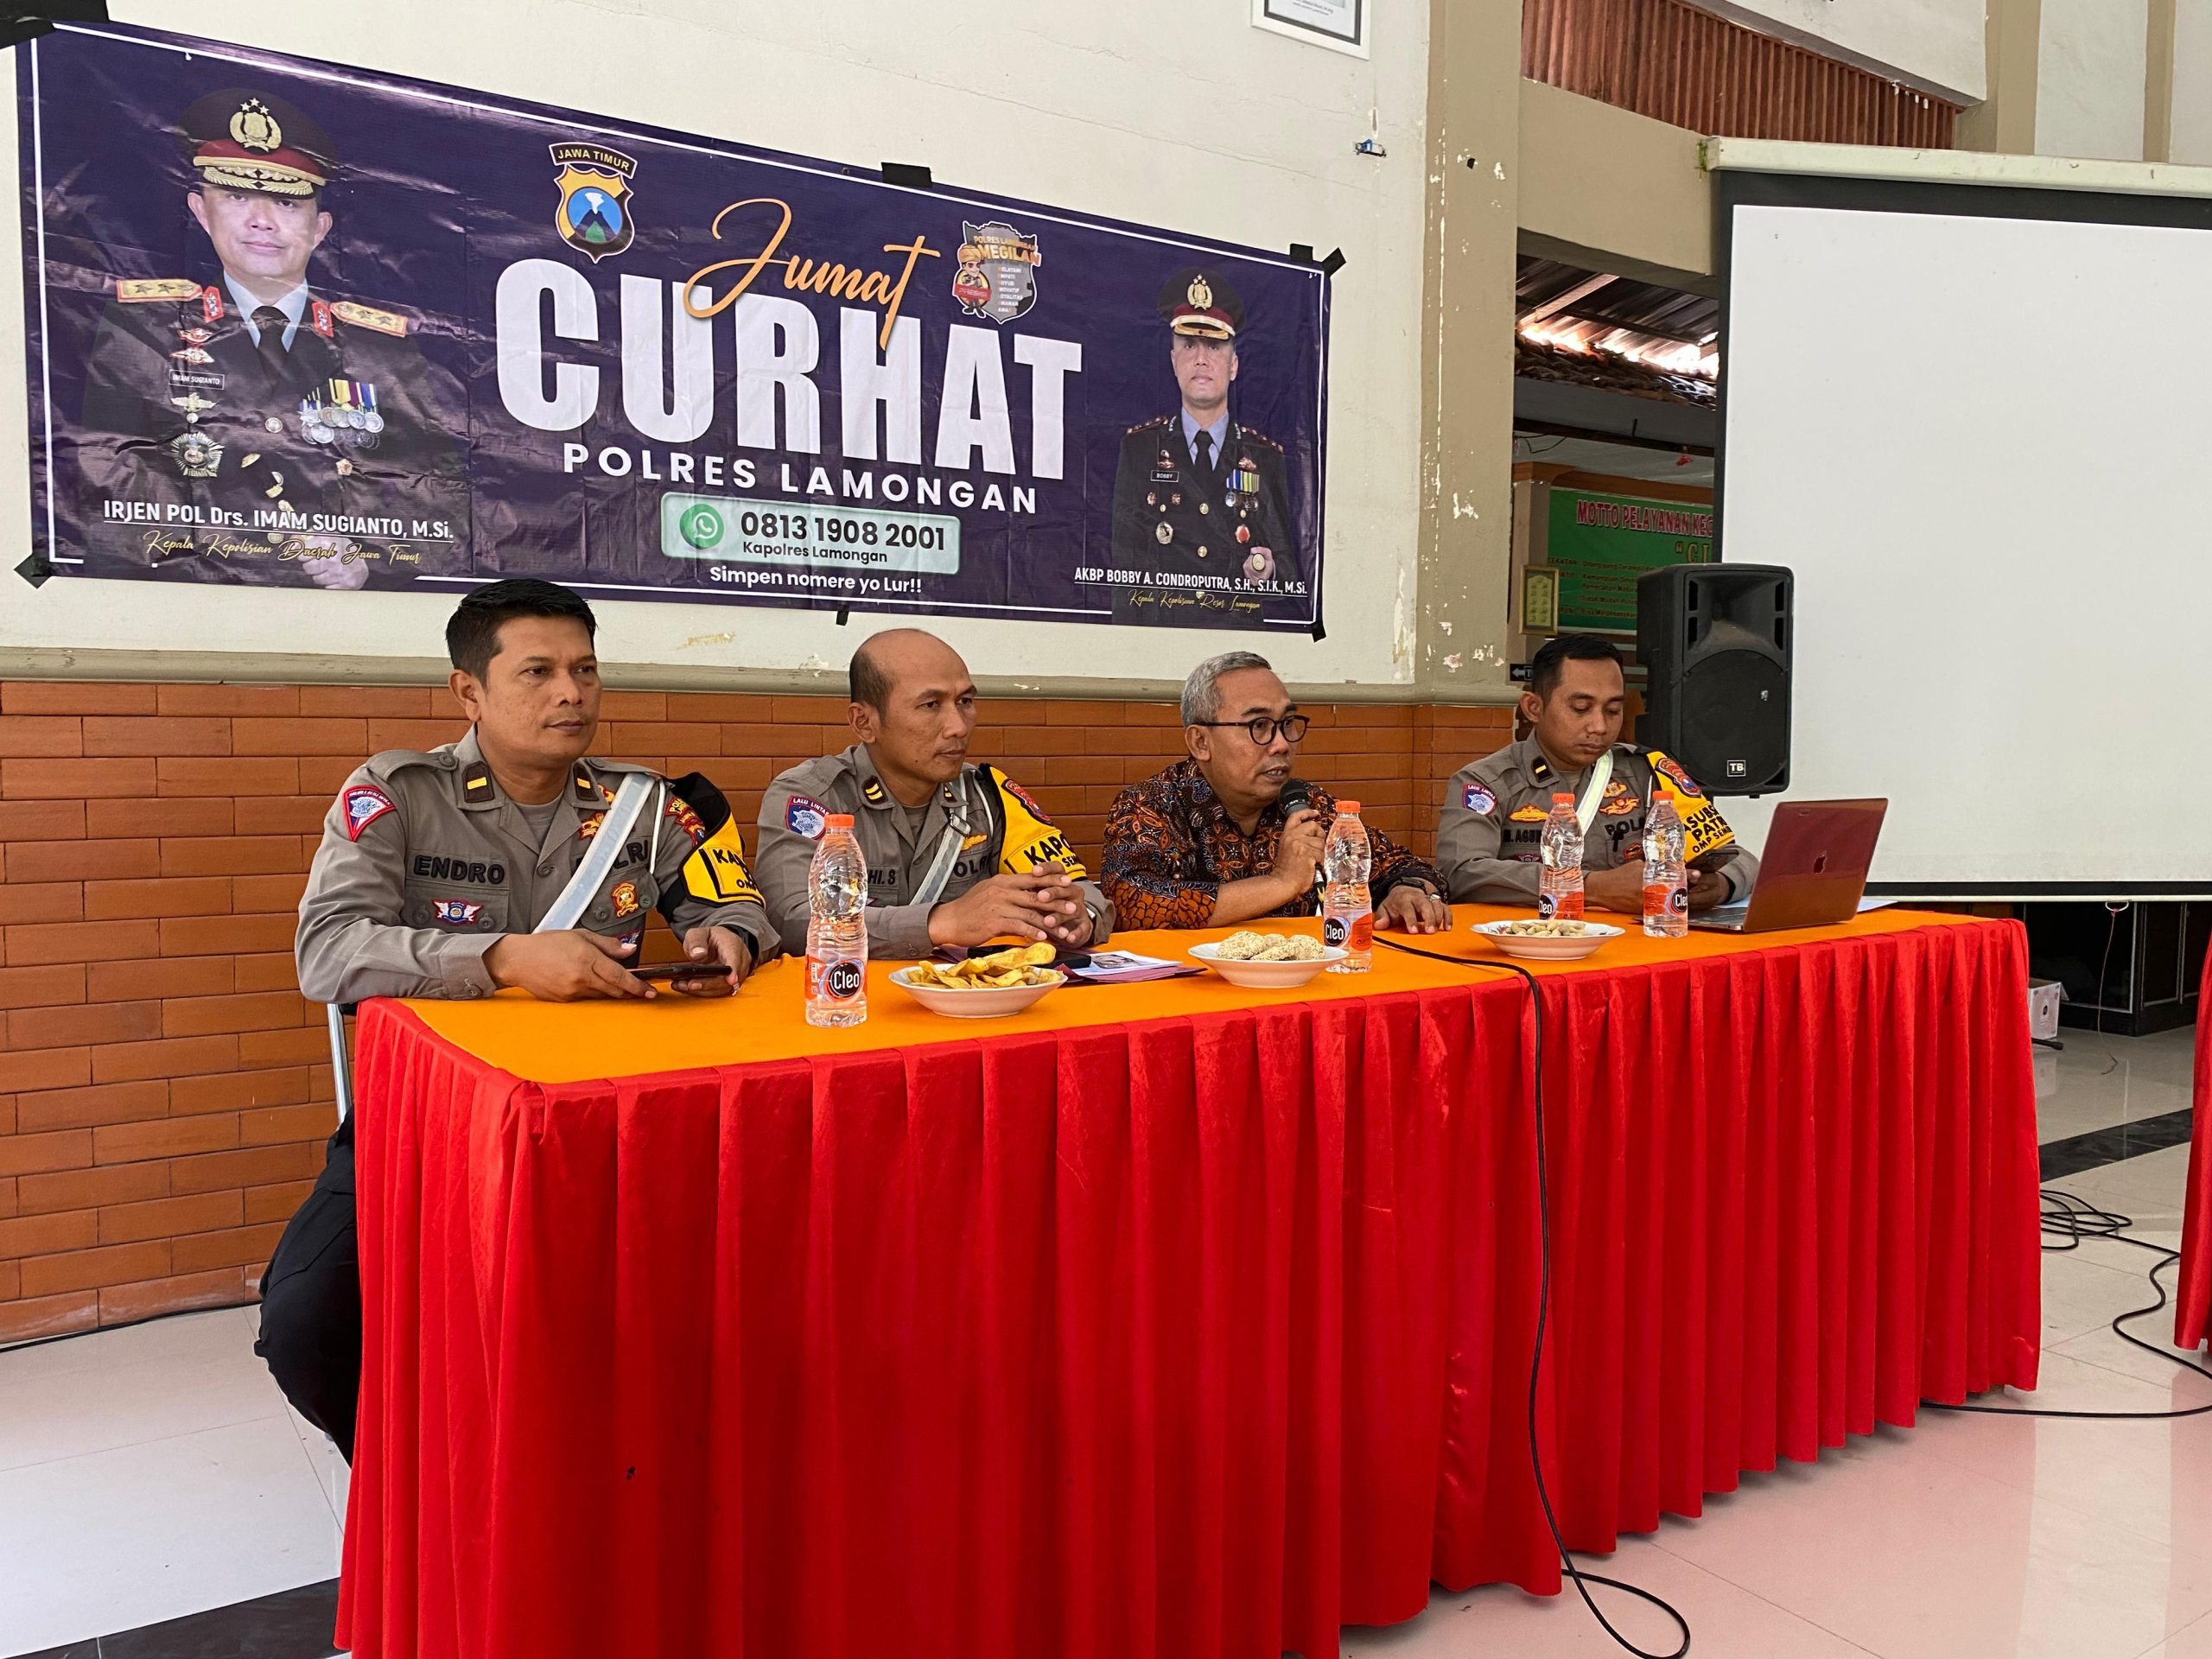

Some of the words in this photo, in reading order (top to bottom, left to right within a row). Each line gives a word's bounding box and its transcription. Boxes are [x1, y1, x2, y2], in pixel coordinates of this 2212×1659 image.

[557, 149, 591, 159] JAWA
[593, 150, 631, 171] TIMUR
[973, 235, 1000, 244] POLRES
[977, 244, 1040, 265] MEGILAN
[683, 198, 940, 351] Jumat
[190, 376, 219, 385] SUGIANTO
[495, 258, 1082, 480] CURHAT
[563, 442, 756, 490] POLRES
[781, 462, 1037, 514] LAMONGAN
[104, 499, 159, 523] IRJEN
[167, 504, 206, 524] POL
[210, 506, 249, 526] Drs.
[254, 510, 308, 530] IMAM
[313, 513, 408, 539] SUGIANTO,
[412, 519, 454, 538] M.Si.
[741, 511, 808, 540] 0813
[815, 517, 879, 545] 1908
[885, 524, 944, 550] 2001
[1576, 499, 1619, 530] MOTTO
[1622, 505, 1690, 537] PELAYANAN
[143, 530, 194, 556] Kepala
[202, 533, 274, 559] Kepolisian
[341, 543, 381, 564] Jawa
[388, 544, 422, 566] Timur
[743, 541, 809, 558] Kapolres
[813, 546, 887, 564] Lamongan
[709, 565, 782, 588] Simpen
[787, 573, 855, 589] nomere
[859, 577, 880, 594] yo
[883, 576, 922, 594] Lur!!
[1074, 567, 1104, 581] AKBP
[1106, 569, 1141, 583] BOBBY
[1143, 572, 1154, 585] A.
[1155, 572, 1232, 592] CONDROPUTRA,
[1234, 577, 1255, 593] S.H.,
[1285, 581, 1307, 594] M.Si.
[1729, 763, 1744, 772] TB
[1693, 837, 1712, 854] OMP
[413, 855, 505, 885] ENDRO
[1325, 924, 1344, 940] Cleo
[834, 970, 860, 989] Cleo
